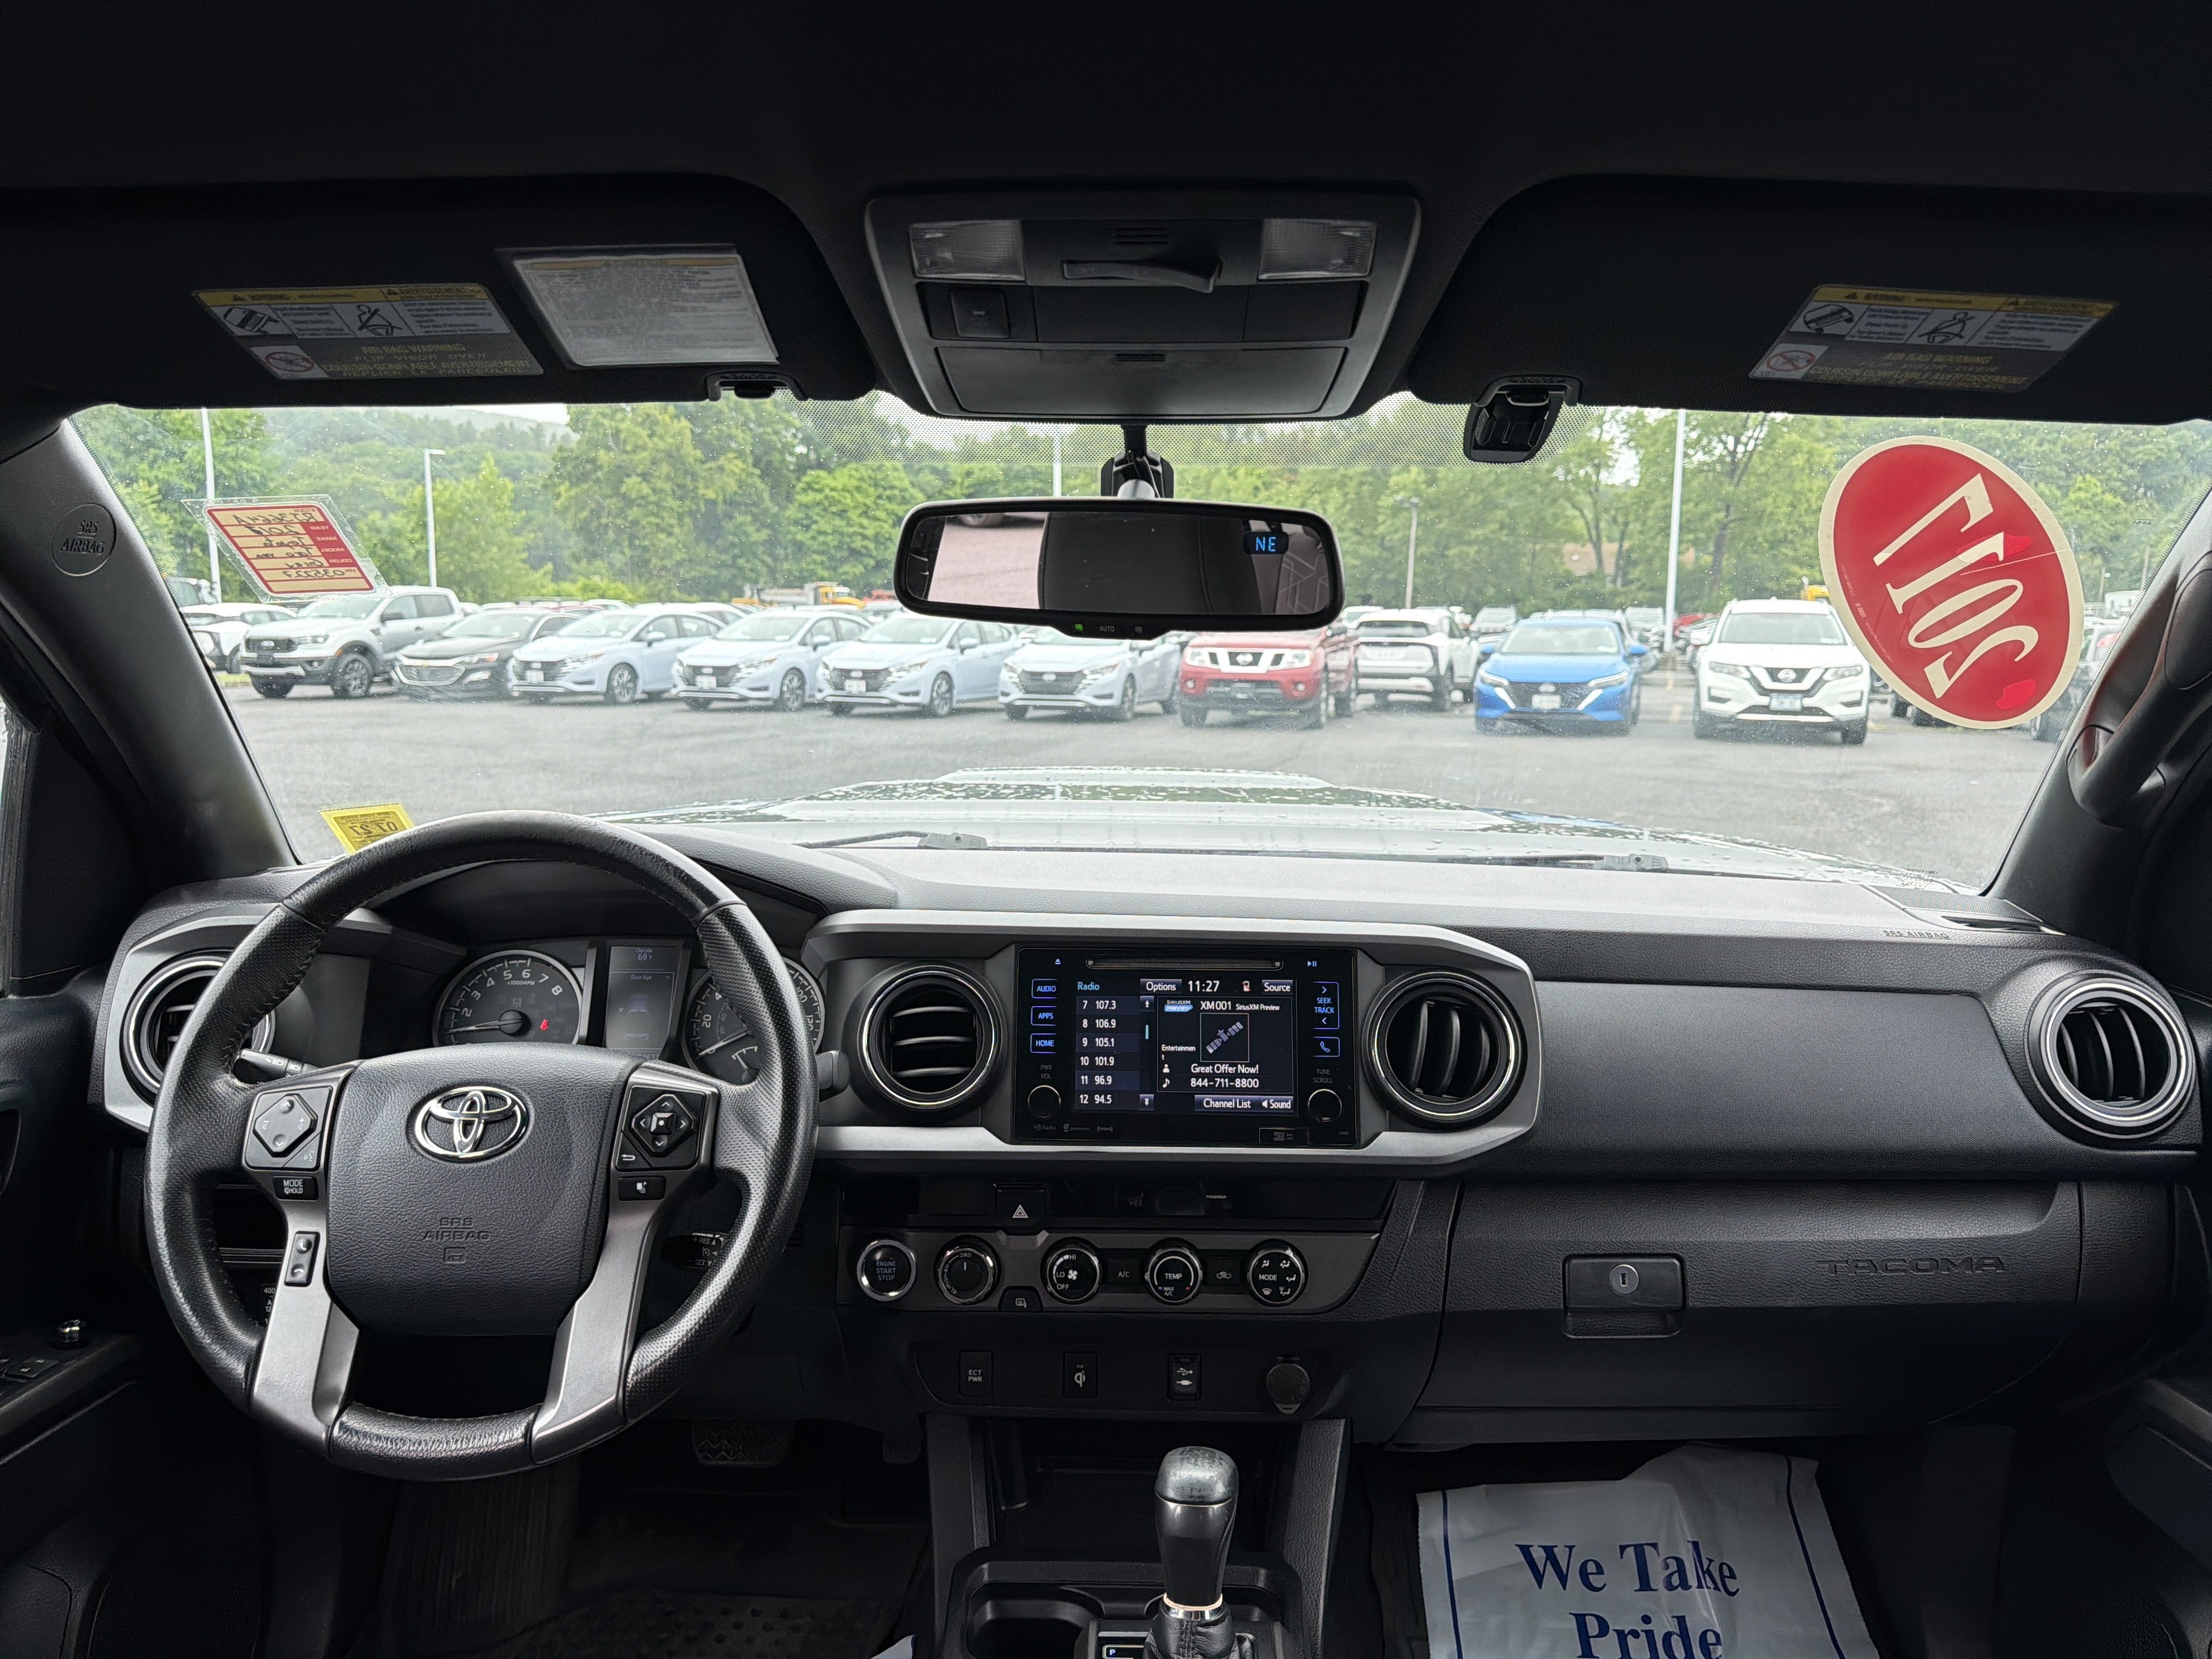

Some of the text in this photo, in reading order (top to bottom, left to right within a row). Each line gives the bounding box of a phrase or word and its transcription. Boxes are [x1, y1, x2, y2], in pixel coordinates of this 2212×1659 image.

[78, 520, 99, 535] SRS
[60, 538, 105, 556] AIRBAG
[1255, 537, 1277, 552] NE
[1906, 931, 1950, 940] AIRBAG
[503, 969, 512, 980] 5
[522, 969, 532, 978] 6
[539, 973, 550, 983] 7
[486, 977, 495, 988] 4
[1077, 981, 1100, 991] Radio
[1146, 981, 1176, 993] Options
[1188, 980, 1220, 992] 11:27
[1264, 983, 1291, 992] Source
[471, 990, 481, 1001] 3
[551, 985, 563, 996] 8
[1082, 1000, 1116, 1009] 7 107.3
[1200, 1001, 1232, 1011] XM001
[461, 1008, 473, 1017] 2
[702, 1014, 712, 1028] 20
[1082, 1019, 1116, 1028] 8 106.9
[1082, 1037, 1115, 1047] 9 105.1
[1080, 1056, 1115, 1066] 10 101.9
[1190, 1064, 1259, 1074] Great Offer Now!
[1080, 1075, 1112, 1085] 11 96.9
[1190, 1078, 1259, 1088] 844-711-8800
[1079, 1094, 1112, 1104] 12 94.5
[1203, 1098, 1251, 1109] Channel List
[1269, 1099, 1291, 1109] Sound
[283, 1179, 304, 1187] MODE
[439, 1217, 473, 1227] SRS
[422, 1229, 490, 1241] AIRBAG
[1814, 1256, 2007, 1276] TACOMA
[1514, 1539, 1741, 1598] We Take
[1568, 1611, 1724, 1659] Pride
